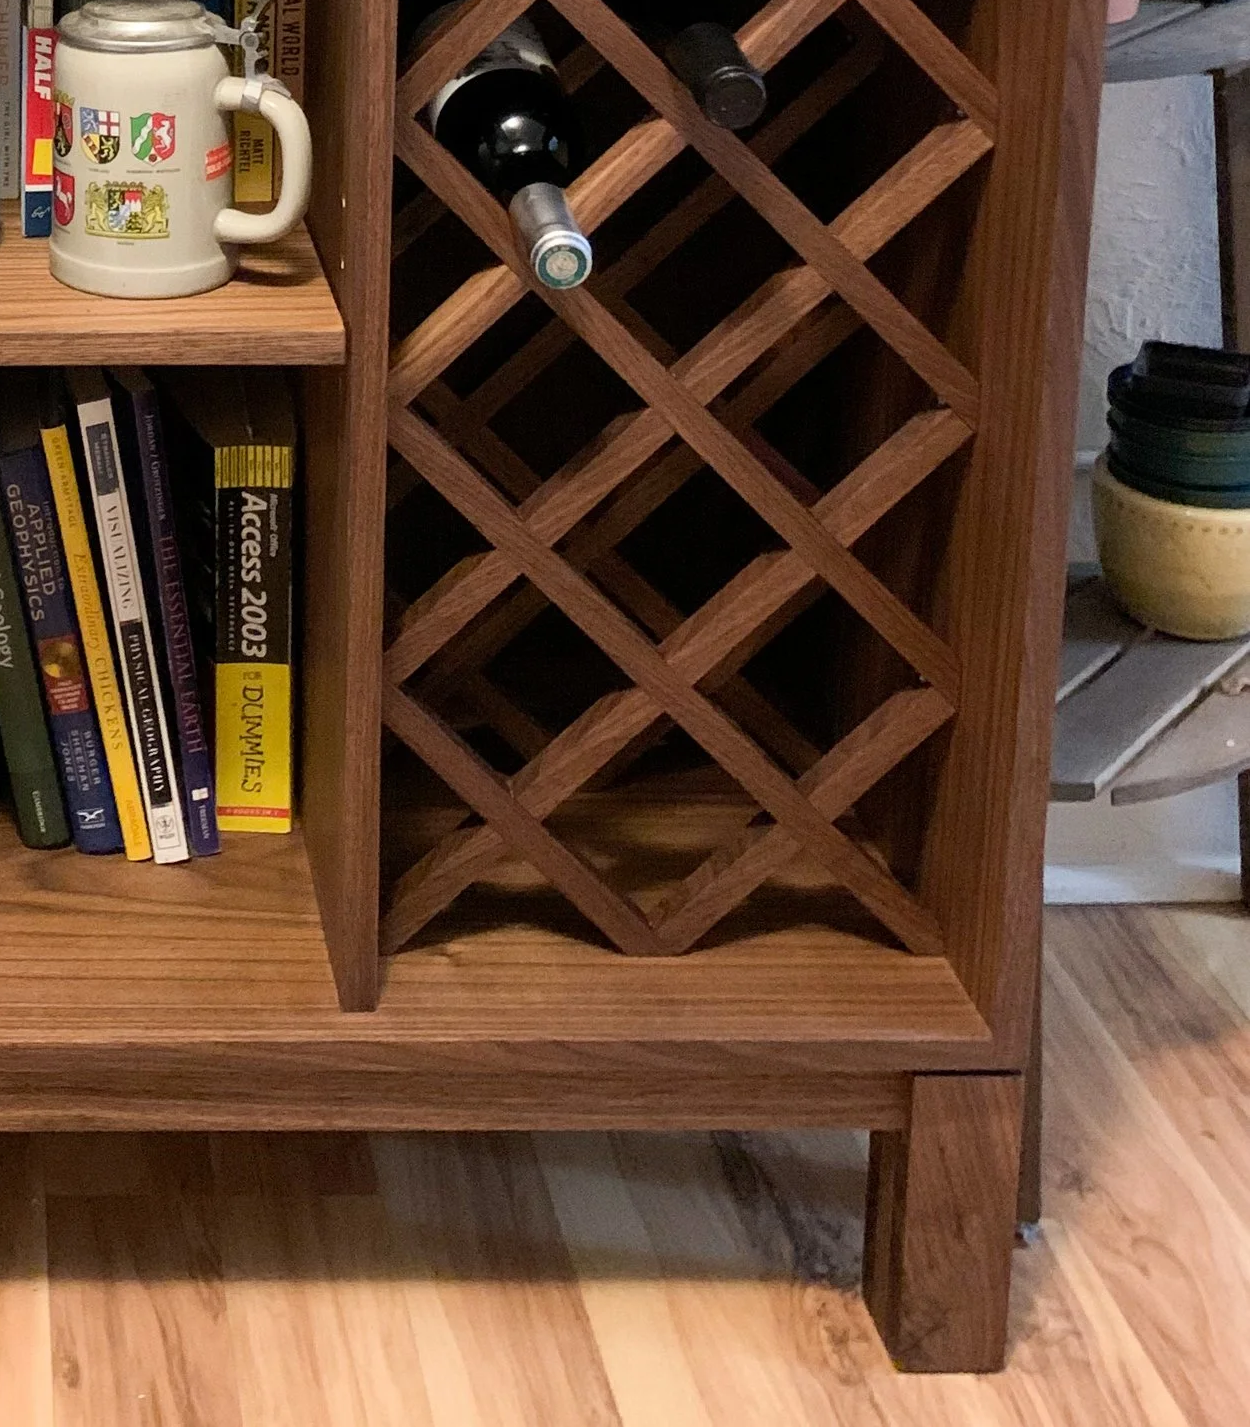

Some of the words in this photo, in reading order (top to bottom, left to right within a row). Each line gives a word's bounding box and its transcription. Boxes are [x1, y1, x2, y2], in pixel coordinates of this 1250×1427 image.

[33, 34, 53, 101] HALF
[280, 20, 301, 76] WORLD
[239, 130, 252, 173] RICHTEL
[252, 138, 265, 165] MATT
[5, 483, 46, 622] GEOPHYSICS
[25, 504, 58, 598] APPLIED
[105, 504, 135, 610] VISUALIZING
[158, 533, 177, 575] THE
[240, 491, 268, 583] Access
[71, 552, 105, 654] Extraordinary
[94, 656, 126, 752] CHICKENS
[164, 581, 194, 682] ESSENTIAL
[240, 586, 268, 658] 2003
[126, 633, 149, 695] PHYSICAL
[135, 697, 166, 793] GEOGRAPHY
[178, 690, 208, 754] EARTH
[238, 683, 266, 795] DUMMIES
[59, 739, 76, 783] JONES
[69, 729, 91, 792] SHEEHAN
[83, 730, 102, 786] BURGER
